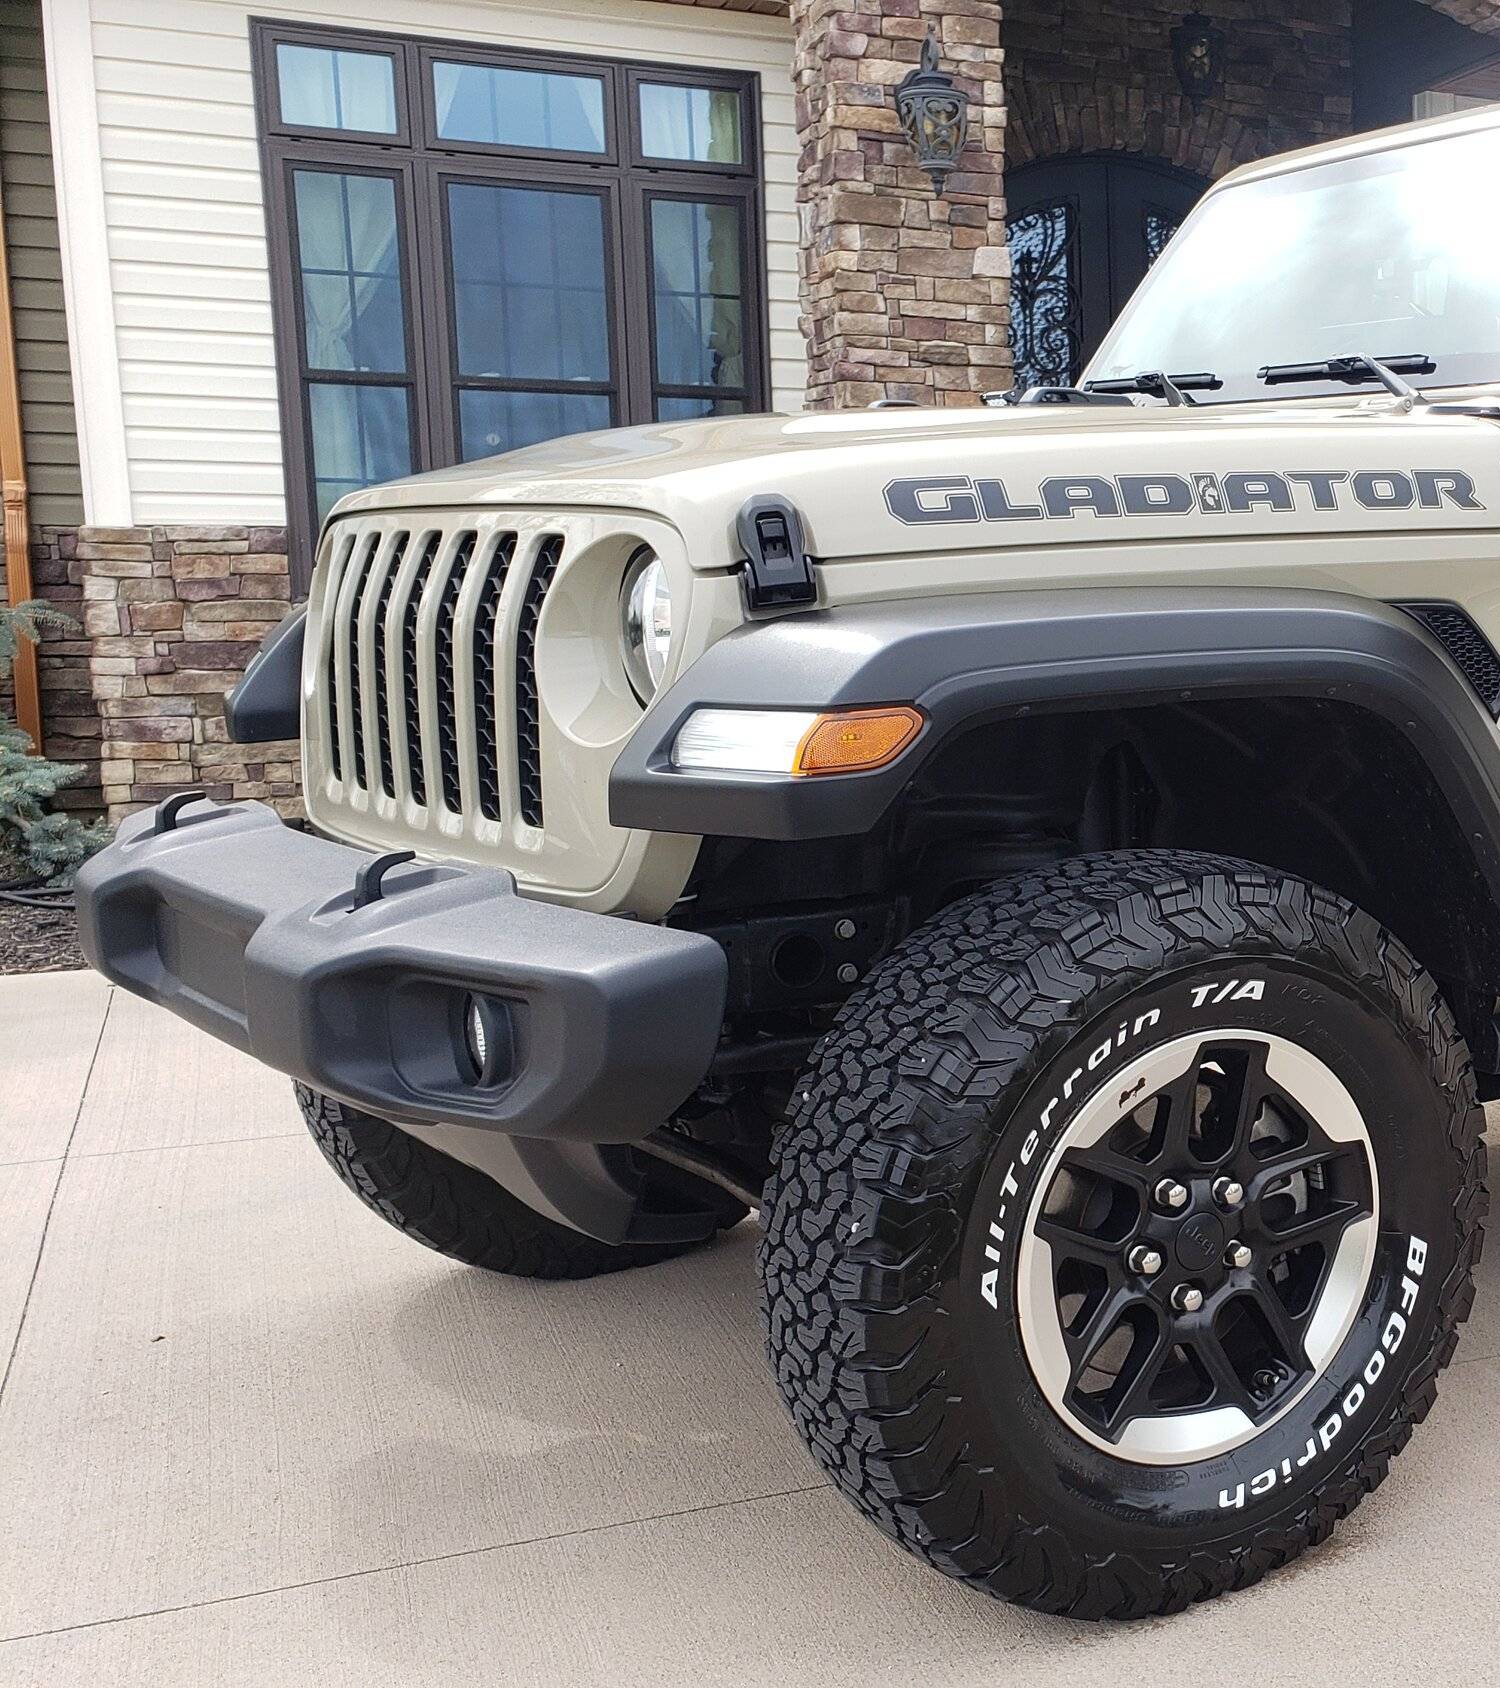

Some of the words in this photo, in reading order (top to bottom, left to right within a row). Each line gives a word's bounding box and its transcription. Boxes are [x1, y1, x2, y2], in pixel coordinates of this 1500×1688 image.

[882, 470, 1487, 526] GLADIATOR
[1190, 979, 1266, 1008] T/A
[979, 1006, 1161, 1311] All-Terrain
[1218, 1232, 1429, 1511] BFGoodrich
